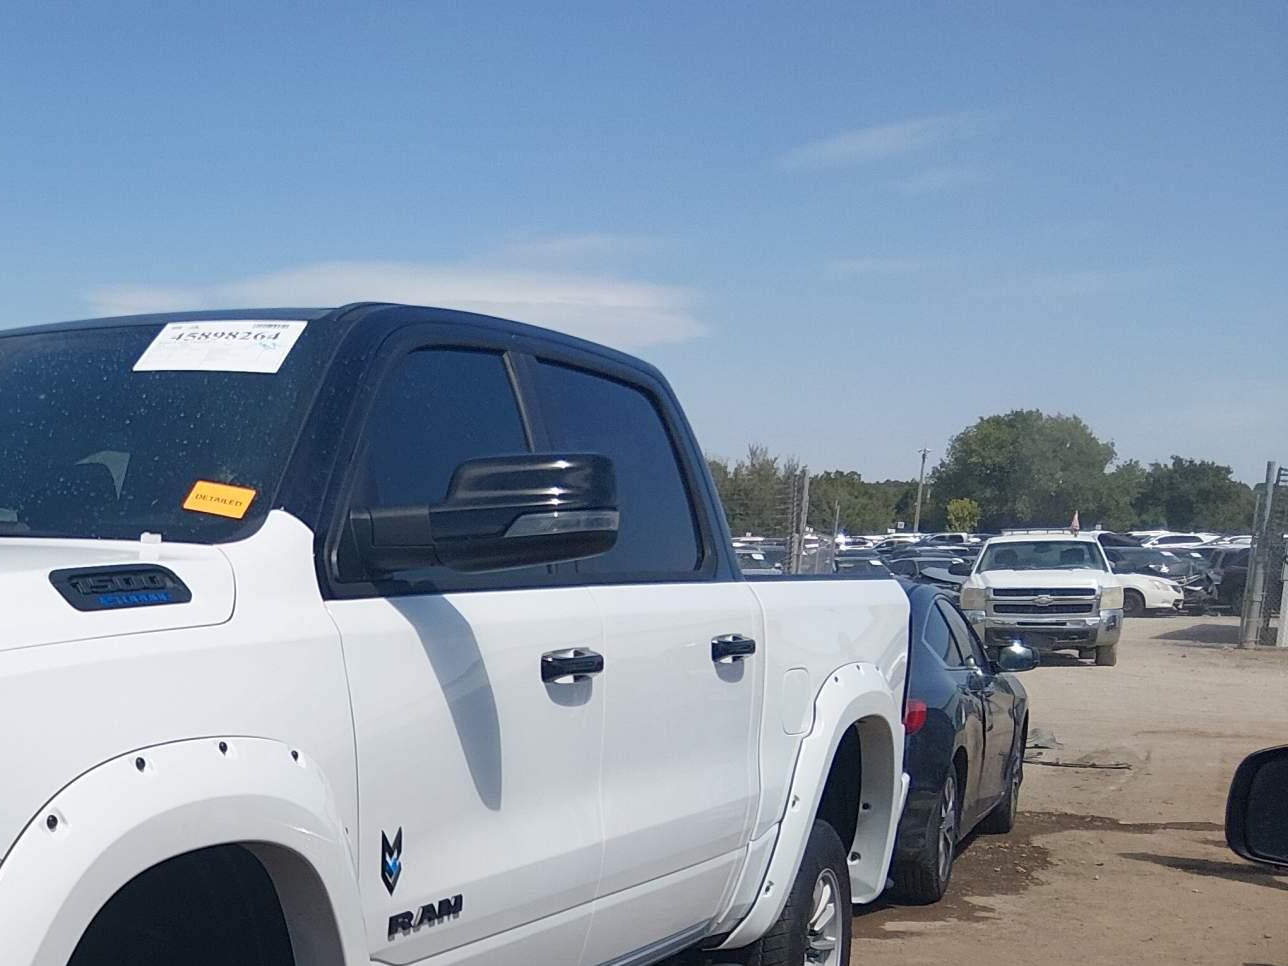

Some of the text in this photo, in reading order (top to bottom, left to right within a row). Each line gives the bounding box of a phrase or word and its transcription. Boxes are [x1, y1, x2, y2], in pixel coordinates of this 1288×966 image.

[170, 331, 281, 342] 45898264
[195, 493, 243, 507] DETAILED
[70, 573, 165, 595] 1500
[388, 893, 463, 940] RAM
